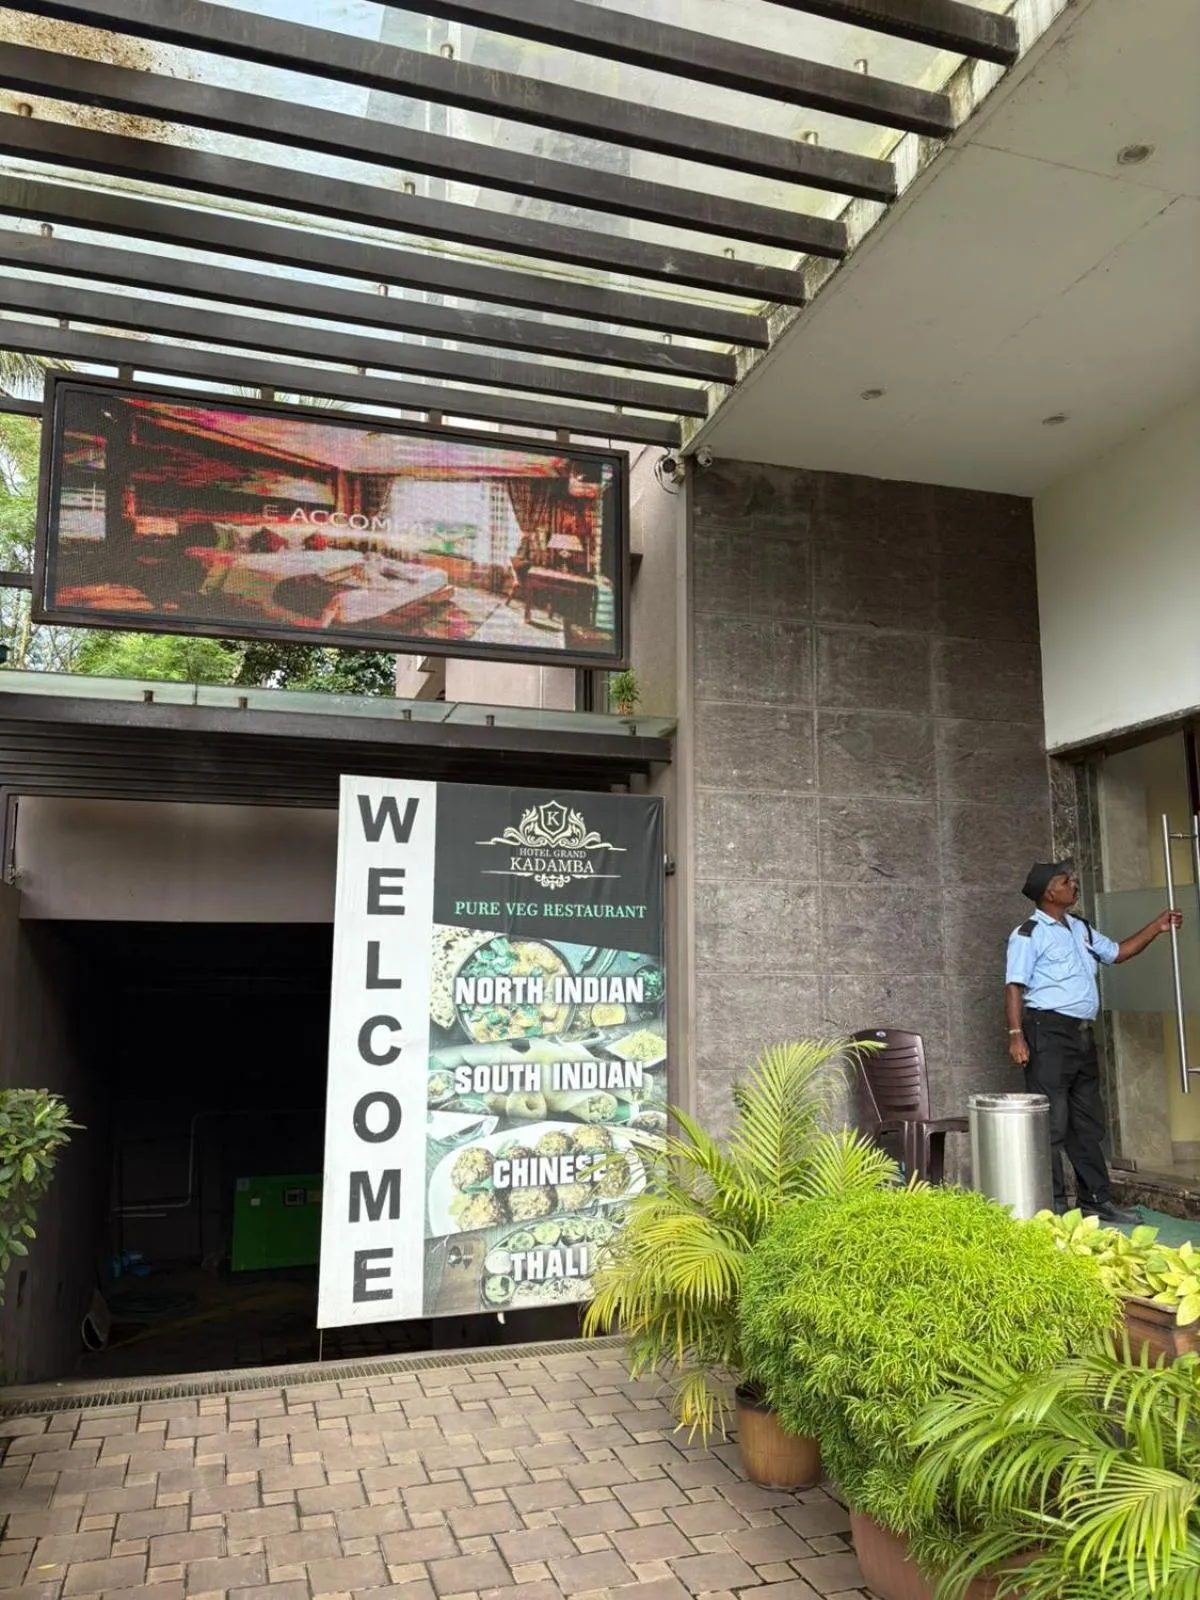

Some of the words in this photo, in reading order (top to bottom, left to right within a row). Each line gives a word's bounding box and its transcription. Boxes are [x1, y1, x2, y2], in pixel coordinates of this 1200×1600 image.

[546, 811, 560, 826] K
[519, 847, 551, 858] HOTEL
[553, 849, 587, 859] GRAND
[510, 857, 595, 873] KADAMBA
[455, 900, 500, 916] PURE
[505, 902, 538, 917] VEG
[543, 903, 647, 919] RESTAURANT
[455, 976, 544, 1004] NORTH
[554, 976, 644, 1003] INDIAN
[348, 794, 421, 1304] WELCOME
[454, 1063, 541, 1094] SOUTH
[553, 1061, 643, 1090] INDIAN
[510, 1247, 588, 1282] THALI
